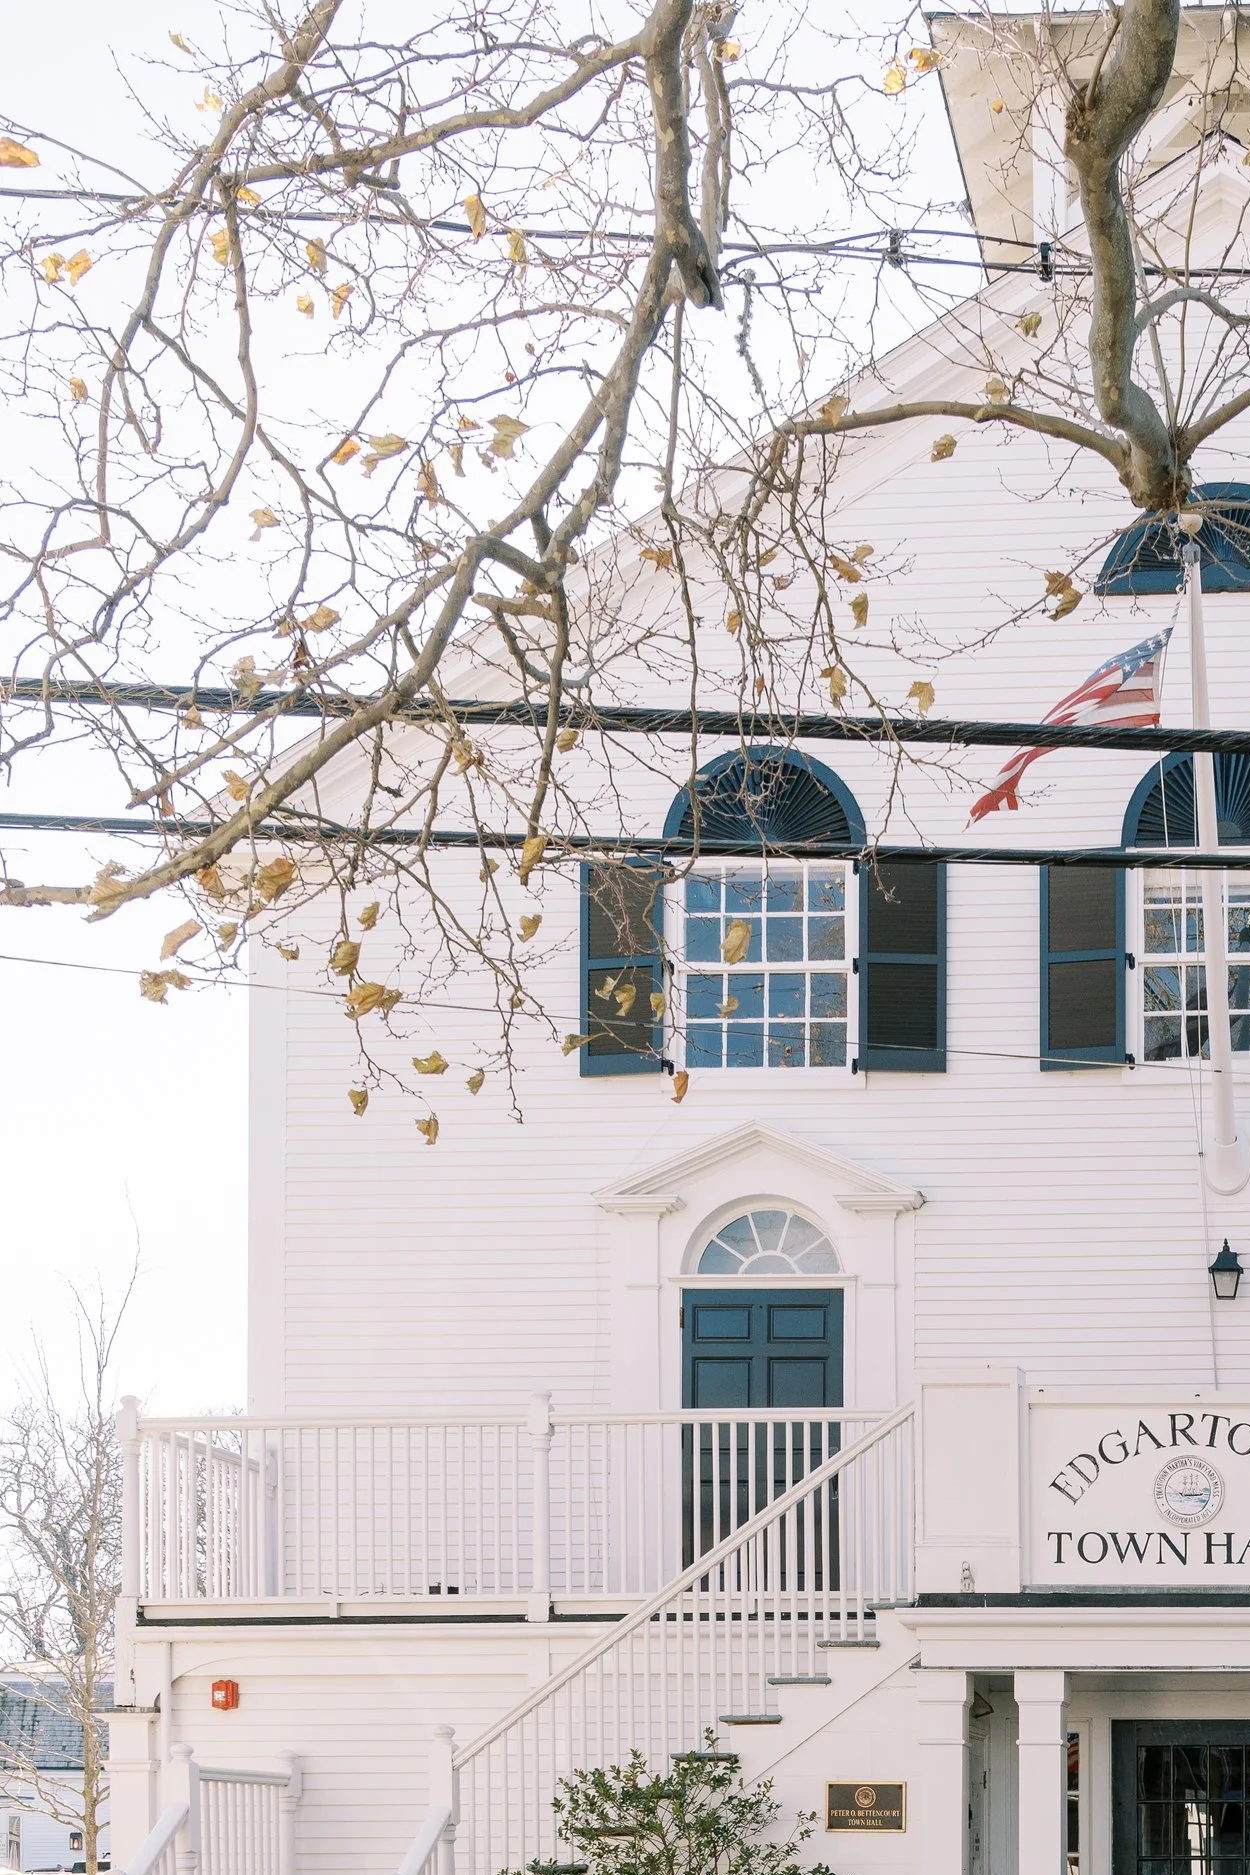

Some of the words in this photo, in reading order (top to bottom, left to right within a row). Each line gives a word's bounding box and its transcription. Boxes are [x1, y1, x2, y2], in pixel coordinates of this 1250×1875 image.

[1167, 1458, 1193, 1471] MARTHA'S
[1193, 1460, 1217, 1481] VINEYARD
[1163, 1508, 1201, 1523] INCORPORATED
[1047, 1532, 1190, 1566] TOWN
[830, 1809, 850, 1817] PETER
[857, 1809, 900, 1817] BETTENCOURT
[848, 1818, 865, 1826] TOWN
[866, 1818, 883, 1826] HALL
